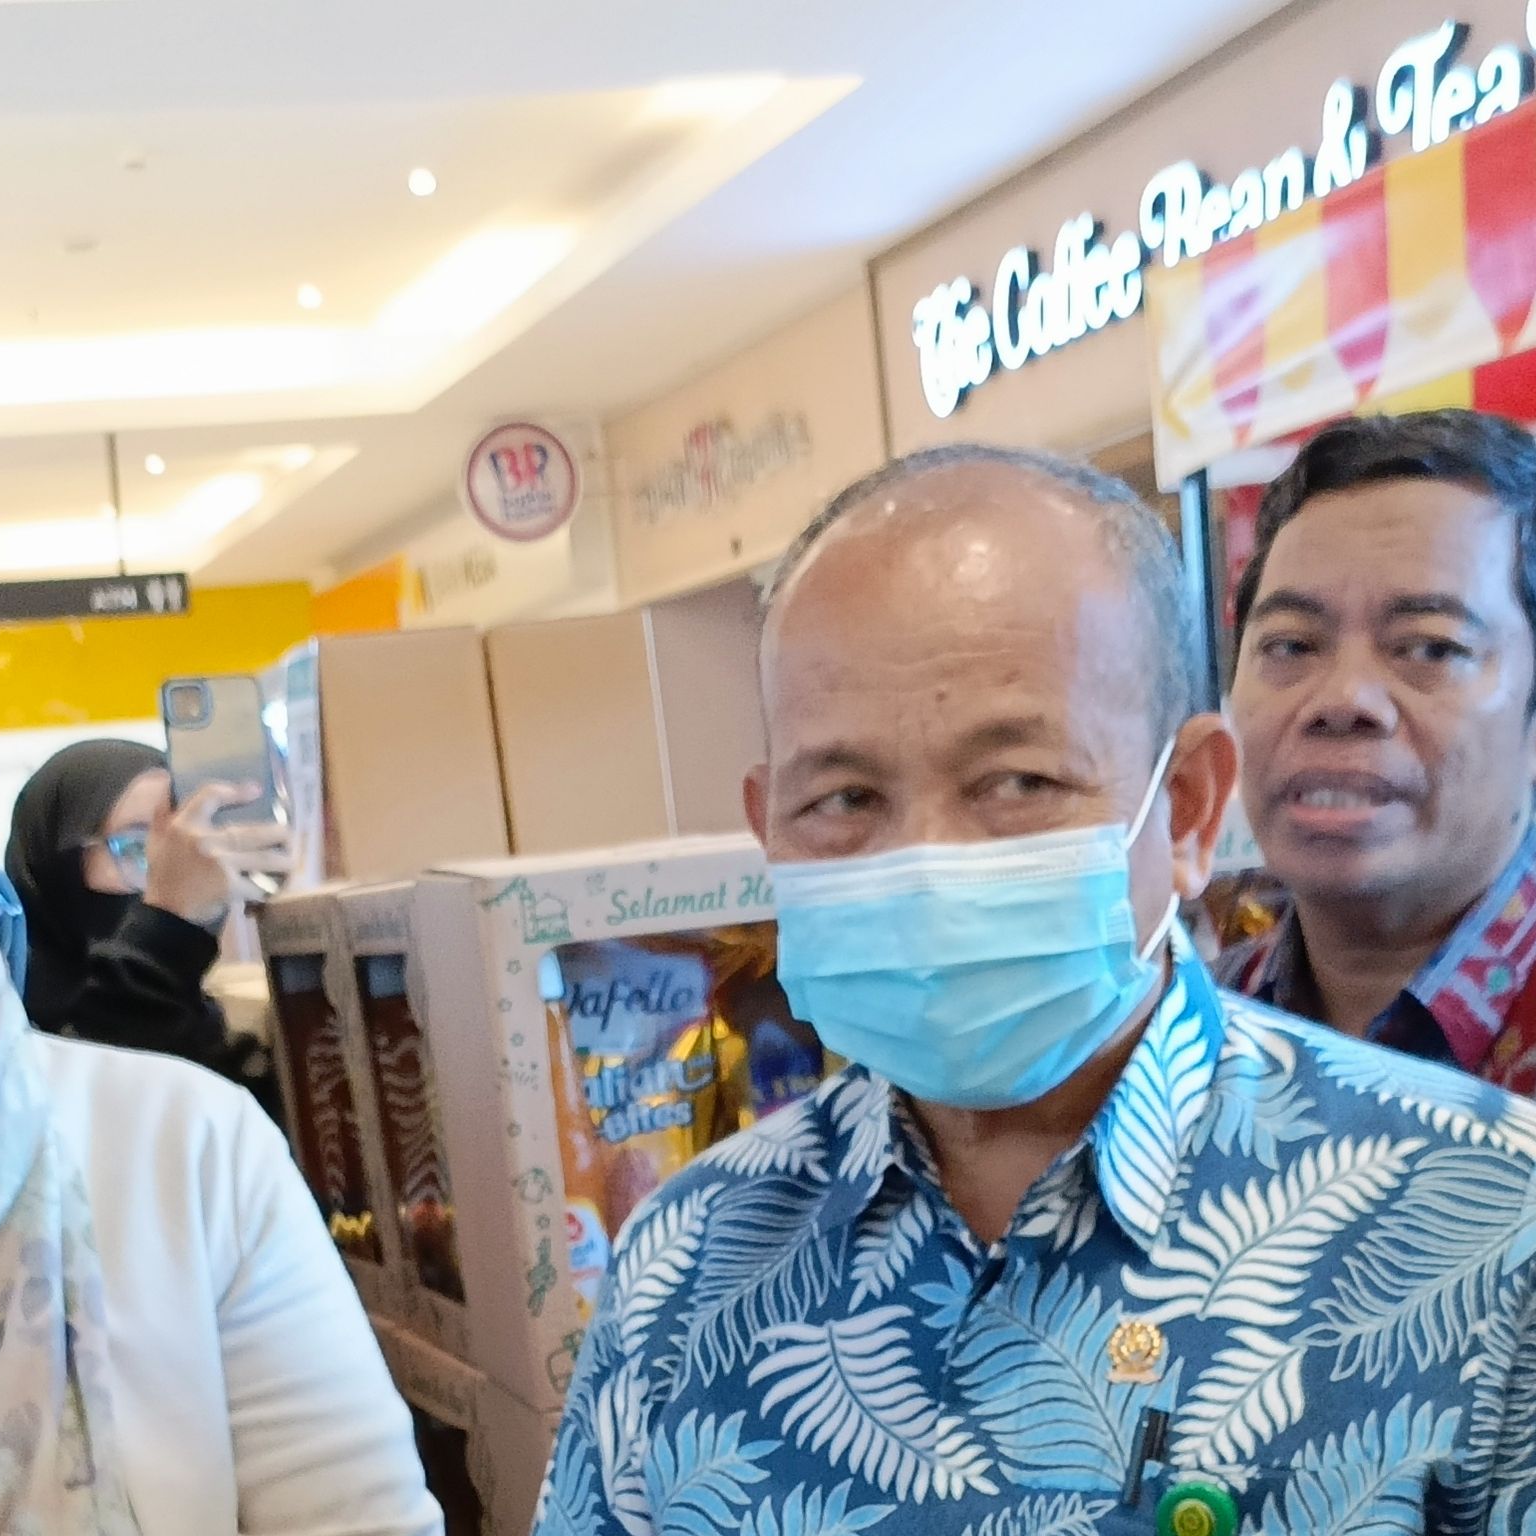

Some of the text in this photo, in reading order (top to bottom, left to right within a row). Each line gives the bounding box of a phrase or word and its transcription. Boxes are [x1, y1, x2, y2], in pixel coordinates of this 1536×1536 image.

[912, 275, 993, 419] The
[992, 210, 1142, 371] Coffee
[1139, 158, 1306, 269] Bean
[1313, 75, 1368, 198] &
[1375, 17, 1521, 153] Tea
[606, 886, 728, 925] Selamat
